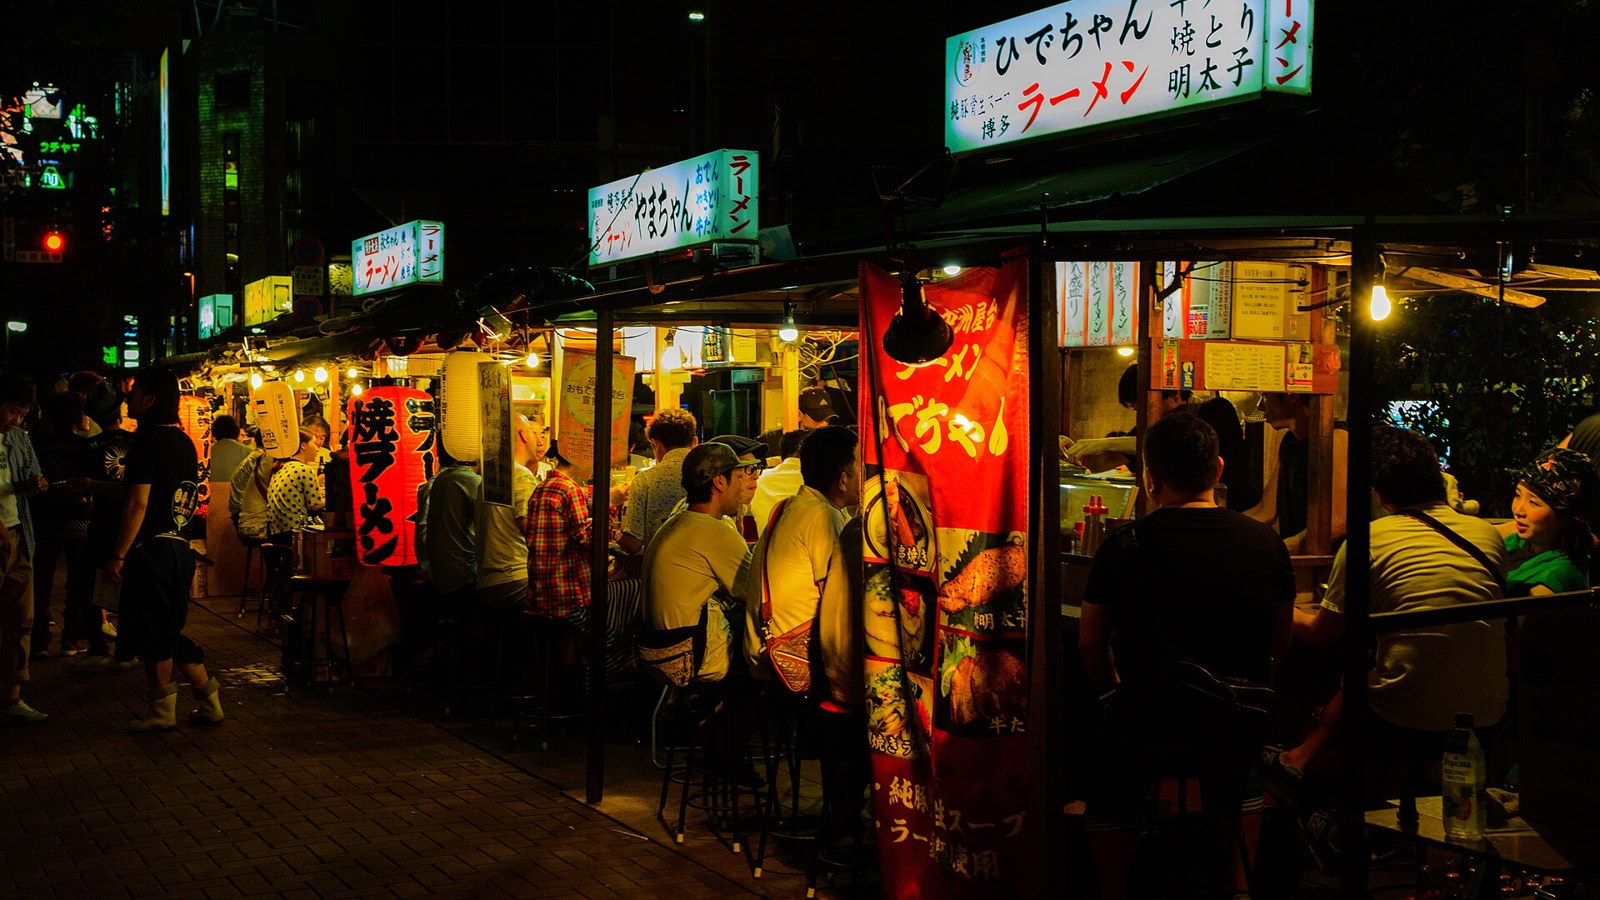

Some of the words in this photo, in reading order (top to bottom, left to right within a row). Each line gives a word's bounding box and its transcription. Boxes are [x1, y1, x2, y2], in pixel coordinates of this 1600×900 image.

[995, 0, 1153, 77] ひでちゃん
[1017, 61, 1150, 134] ラーメン
[1168, 47, 1255, 99] 明太子
[982, 114, 1011, 140] 博多
[695, 159, 719, 186] おでん
[729, 155, 753, 235] ラーメン
[634, 178, 694, 240] やまちゃん
[695, 187, 719, 212] やきとり
[695, 214, 719, 238] 牛たん
[366, 255, 400, 289] ラーメン
[421, 225, 442, 279] ラーメン
[351, 397, 400, 565] 焼ラーメン
